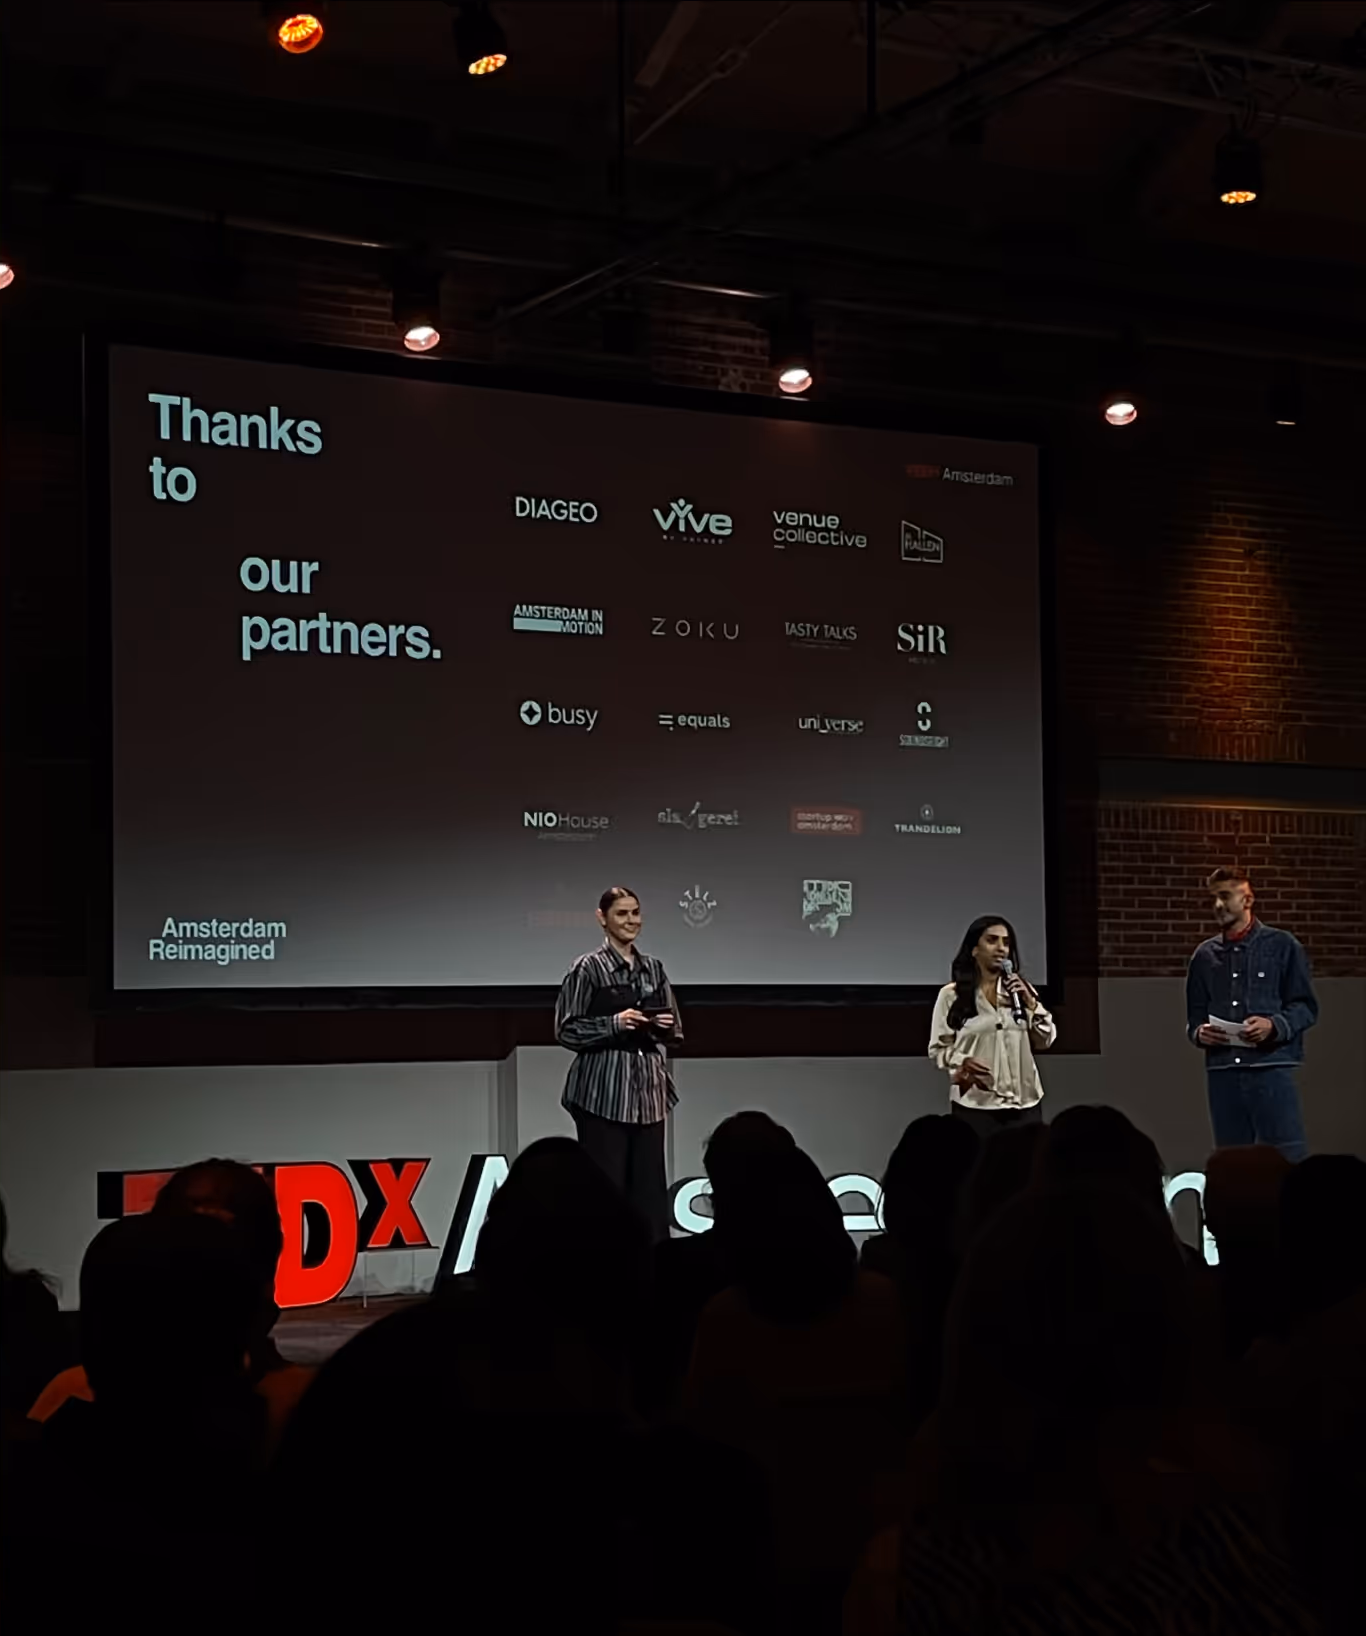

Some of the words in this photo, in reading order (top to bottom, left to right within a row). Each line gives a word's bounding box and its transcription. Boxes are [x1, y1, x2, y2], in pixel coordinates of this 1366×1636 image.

[148, 393, 323, 457] Thanks
[148, 457, 197, 504] to
[514, 495, 599, 524] DIAGEO
[773, 509, 840, 530] venue
[773, 528, 868, 548] collective
[240, 554, 320, 596] our
[514, 604, 587, 622] AMSTERDAM
[589, 608, 604, 623] IN
[240, 611, 443, 662] partners.
[562, 621, 604, 637] MOTION
[785, 621, 822, 638] TASTY
[823, 623, 858, 641] TALKS
[547, 702, 599, 733] busy
[677, 712, 731, 732] equals
[162, 916, 288, 942] Amsterdam
[148, 937, 277, 965] Reimagined
